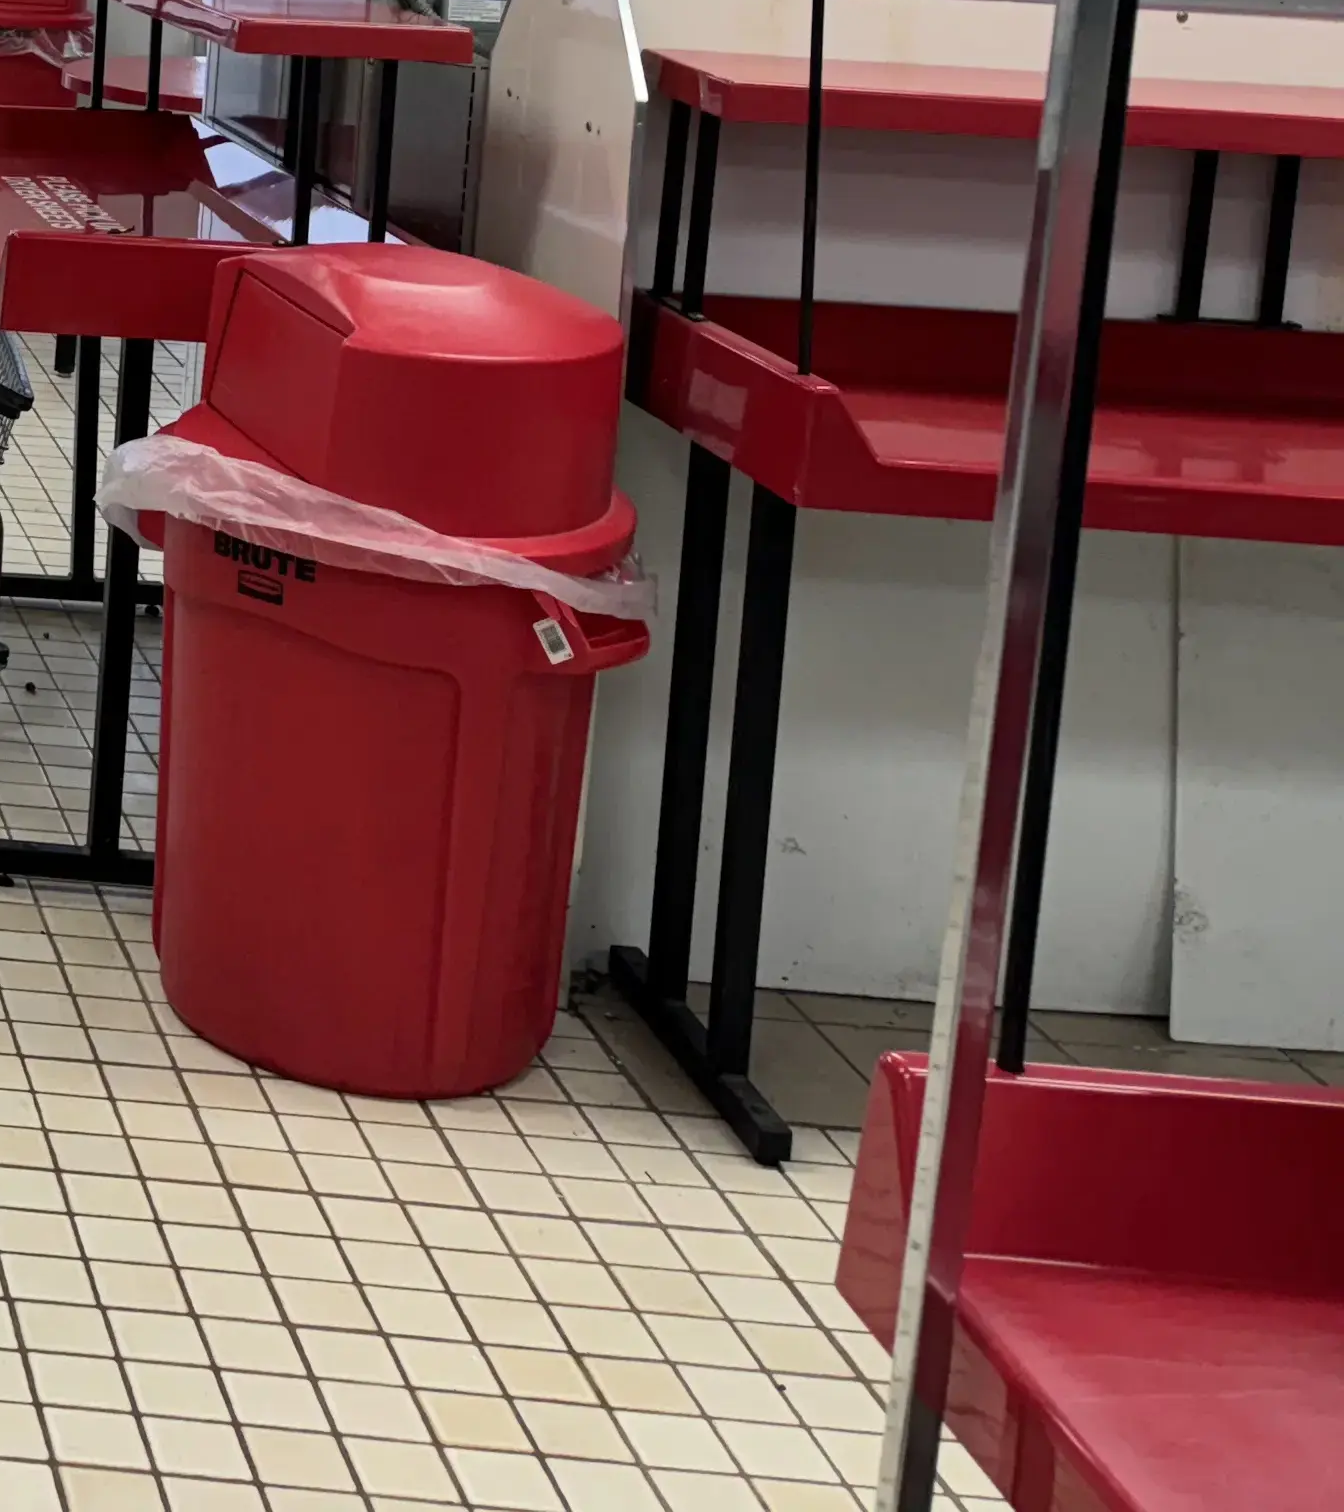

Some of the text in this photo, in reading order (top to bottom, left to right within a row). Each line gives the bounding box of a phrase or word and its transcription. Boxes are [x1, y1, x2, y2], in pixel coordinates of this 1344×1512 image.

[0, 175, 86, 229] DRYER SHEETS
[36, 175, 93, 203] PLEASE
[214, 529, 317, 583] BRUTE
